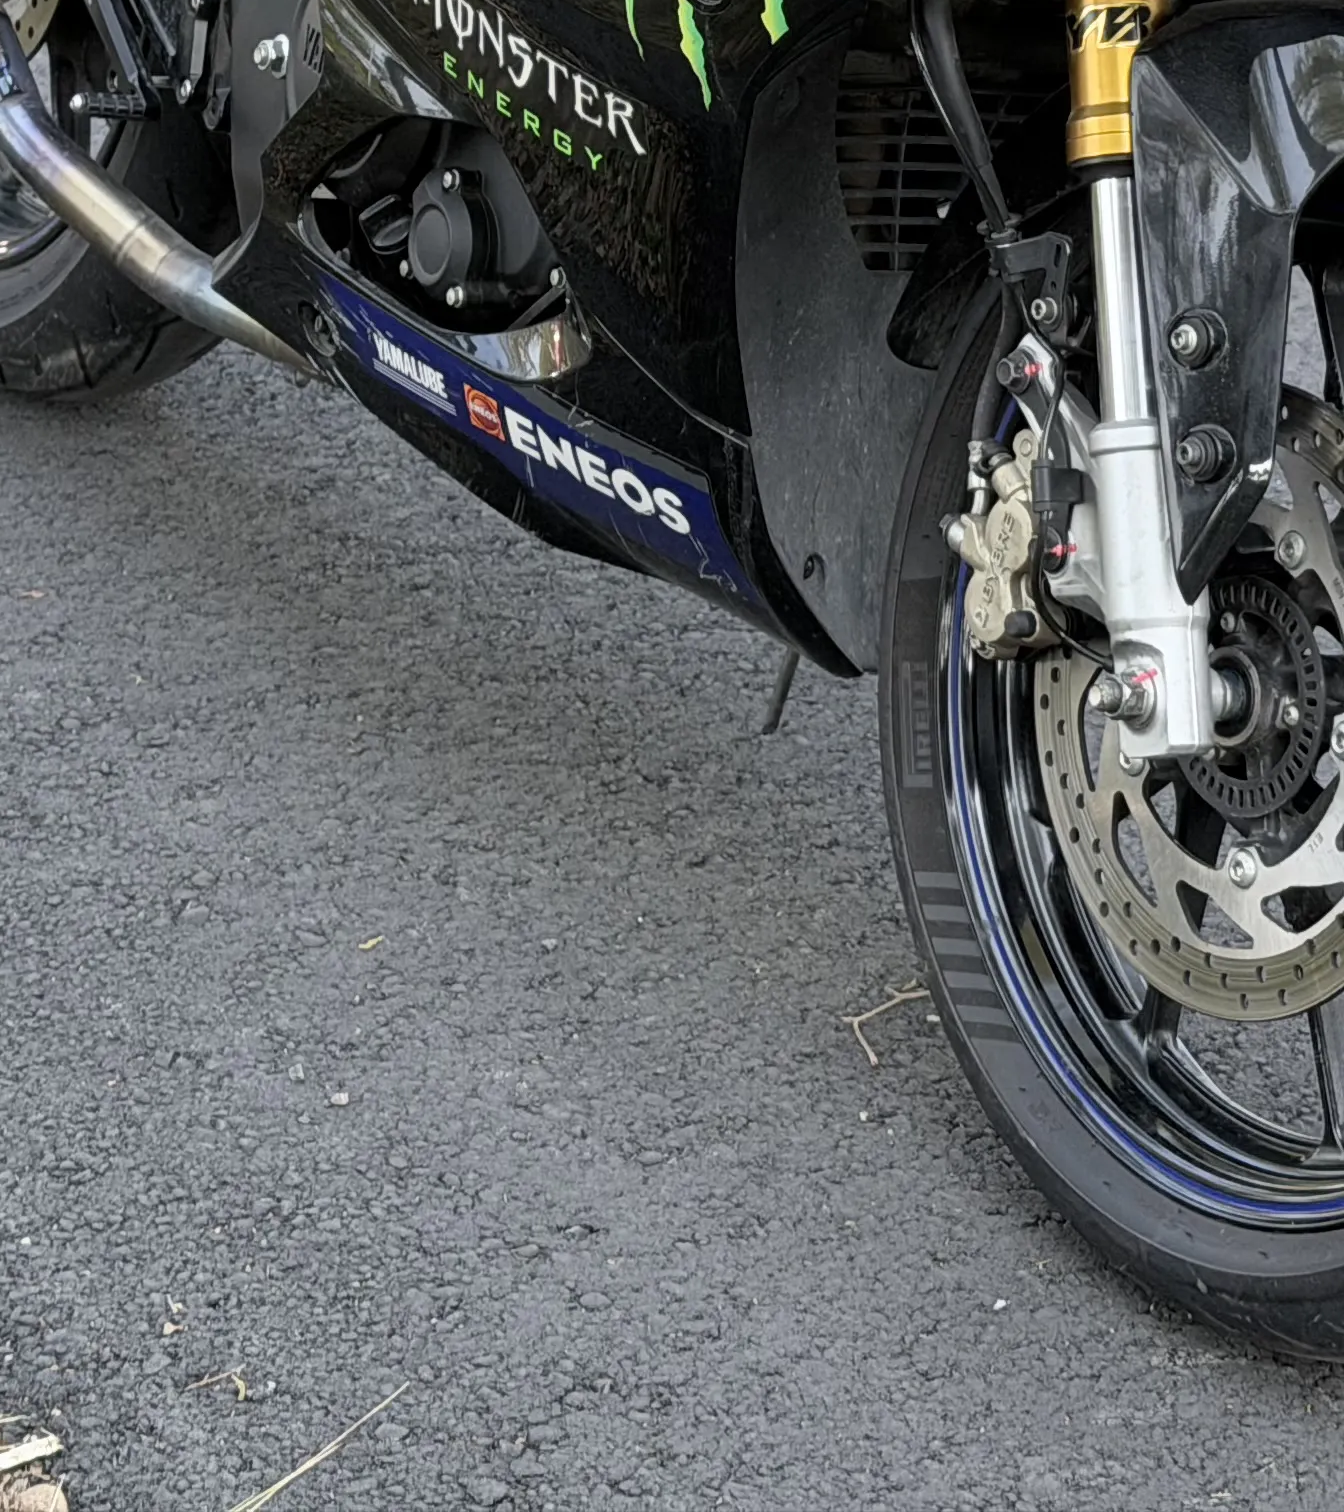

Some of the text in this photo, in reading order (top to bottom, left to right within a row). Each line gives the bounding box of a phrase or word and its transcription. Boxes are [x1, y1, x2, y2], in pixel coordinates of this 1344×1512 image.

[443, 50, 603, 171] ENERGY
[372, 332, 449, 399] YAMALUBE
[504, 406, 691, 535] ENEOS
